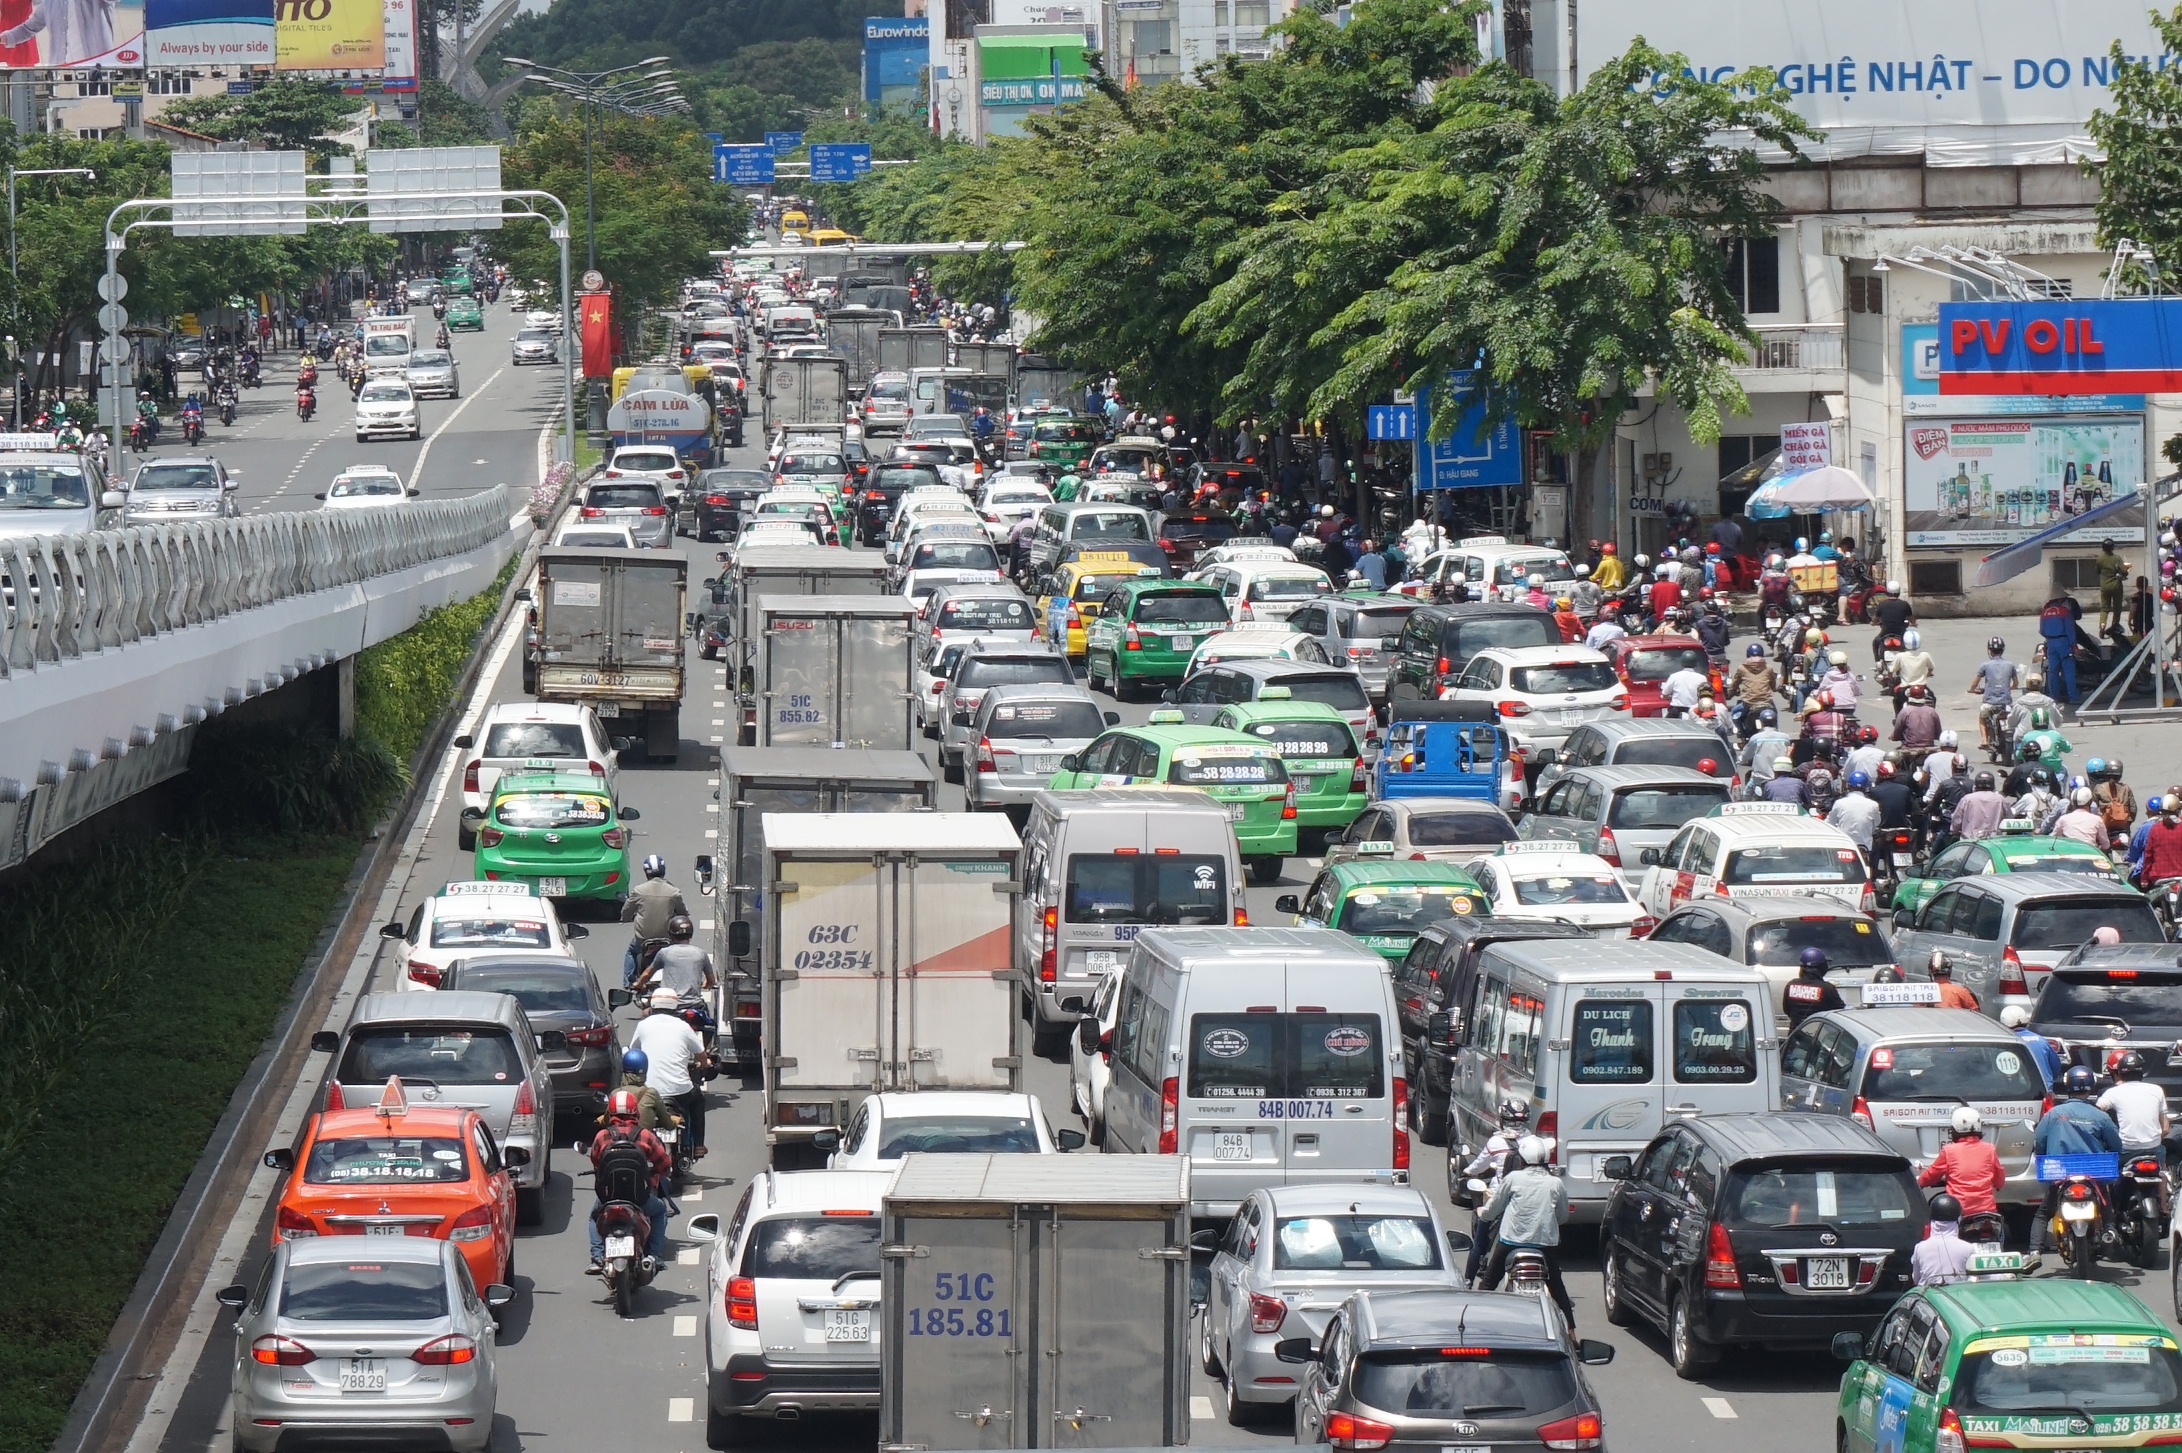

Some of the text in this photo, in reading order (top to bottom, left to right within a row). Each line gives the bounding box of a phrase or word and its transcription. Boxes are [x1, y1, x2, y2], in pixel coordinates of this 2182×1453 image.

[160, 41, 269, 56] Always by your side
[1867, 54, 1973, 100] NHẬT
[2014, 57, 2071, 90] DO
[1020, 84, 1033, 98] OK
[1951, 317, 2104, 355] PV OIL
[772, 621, 814, 630] ISUZU
[790, 694, 811, 708] 51C
[780, 710, 820, 723] 855.82
[1299, 742, 1313, 753] 28
[1314, 741, 1328, 753] 28
[1219, 767, 1234, 779] 28
[1235, 766, 1249, 779] 28
[1250, 766, 1265, 779] 28
[974, 864, 1006, 872] KHANH
[497, 885, 510, 893] 27
[513, 885, 526, 893] 27
[808, 924, 859, 944] 63C
[794, 950, 873, 970] 02354
[1093, 952, 1111, 962] 95B
[1583, 1011, 1600, 1020] DU
[1998, 1057, 2018, 1070] 1119
[1258, 1100, 1333, 1118] 84B 007.74
[1882, 1108, 1916, 1117] SAIGON
[1223, 1135, 1243, 1146] 84B
[1215, 1147, 1250, 1159] 007.74
[1816, 1259, 1840, 1272] 72N
[1812, 1272, 1844, 1285] 3018
[934, 1272, 994, 1301] 51C
[835, 1312, 858, 1325] 51G
[908, 1307, 1012, 1337] 185.81
[827, 1326, 868, 1340] 225.63
[1997, 1353, 2023, 1362] 5635
[351, 1360, 374, 1374] 51A
[341, 1374, 384, 1389] 788.29
[1965, 1420, 1999, 1432] TAXI
[2113, 1416, 2130, 1433] 38
[2133, 1415, 2150, 1431] 38
[2152, 1414, 2170, 1430] 38
[1458, 1426, 1475, 1435] KIA
